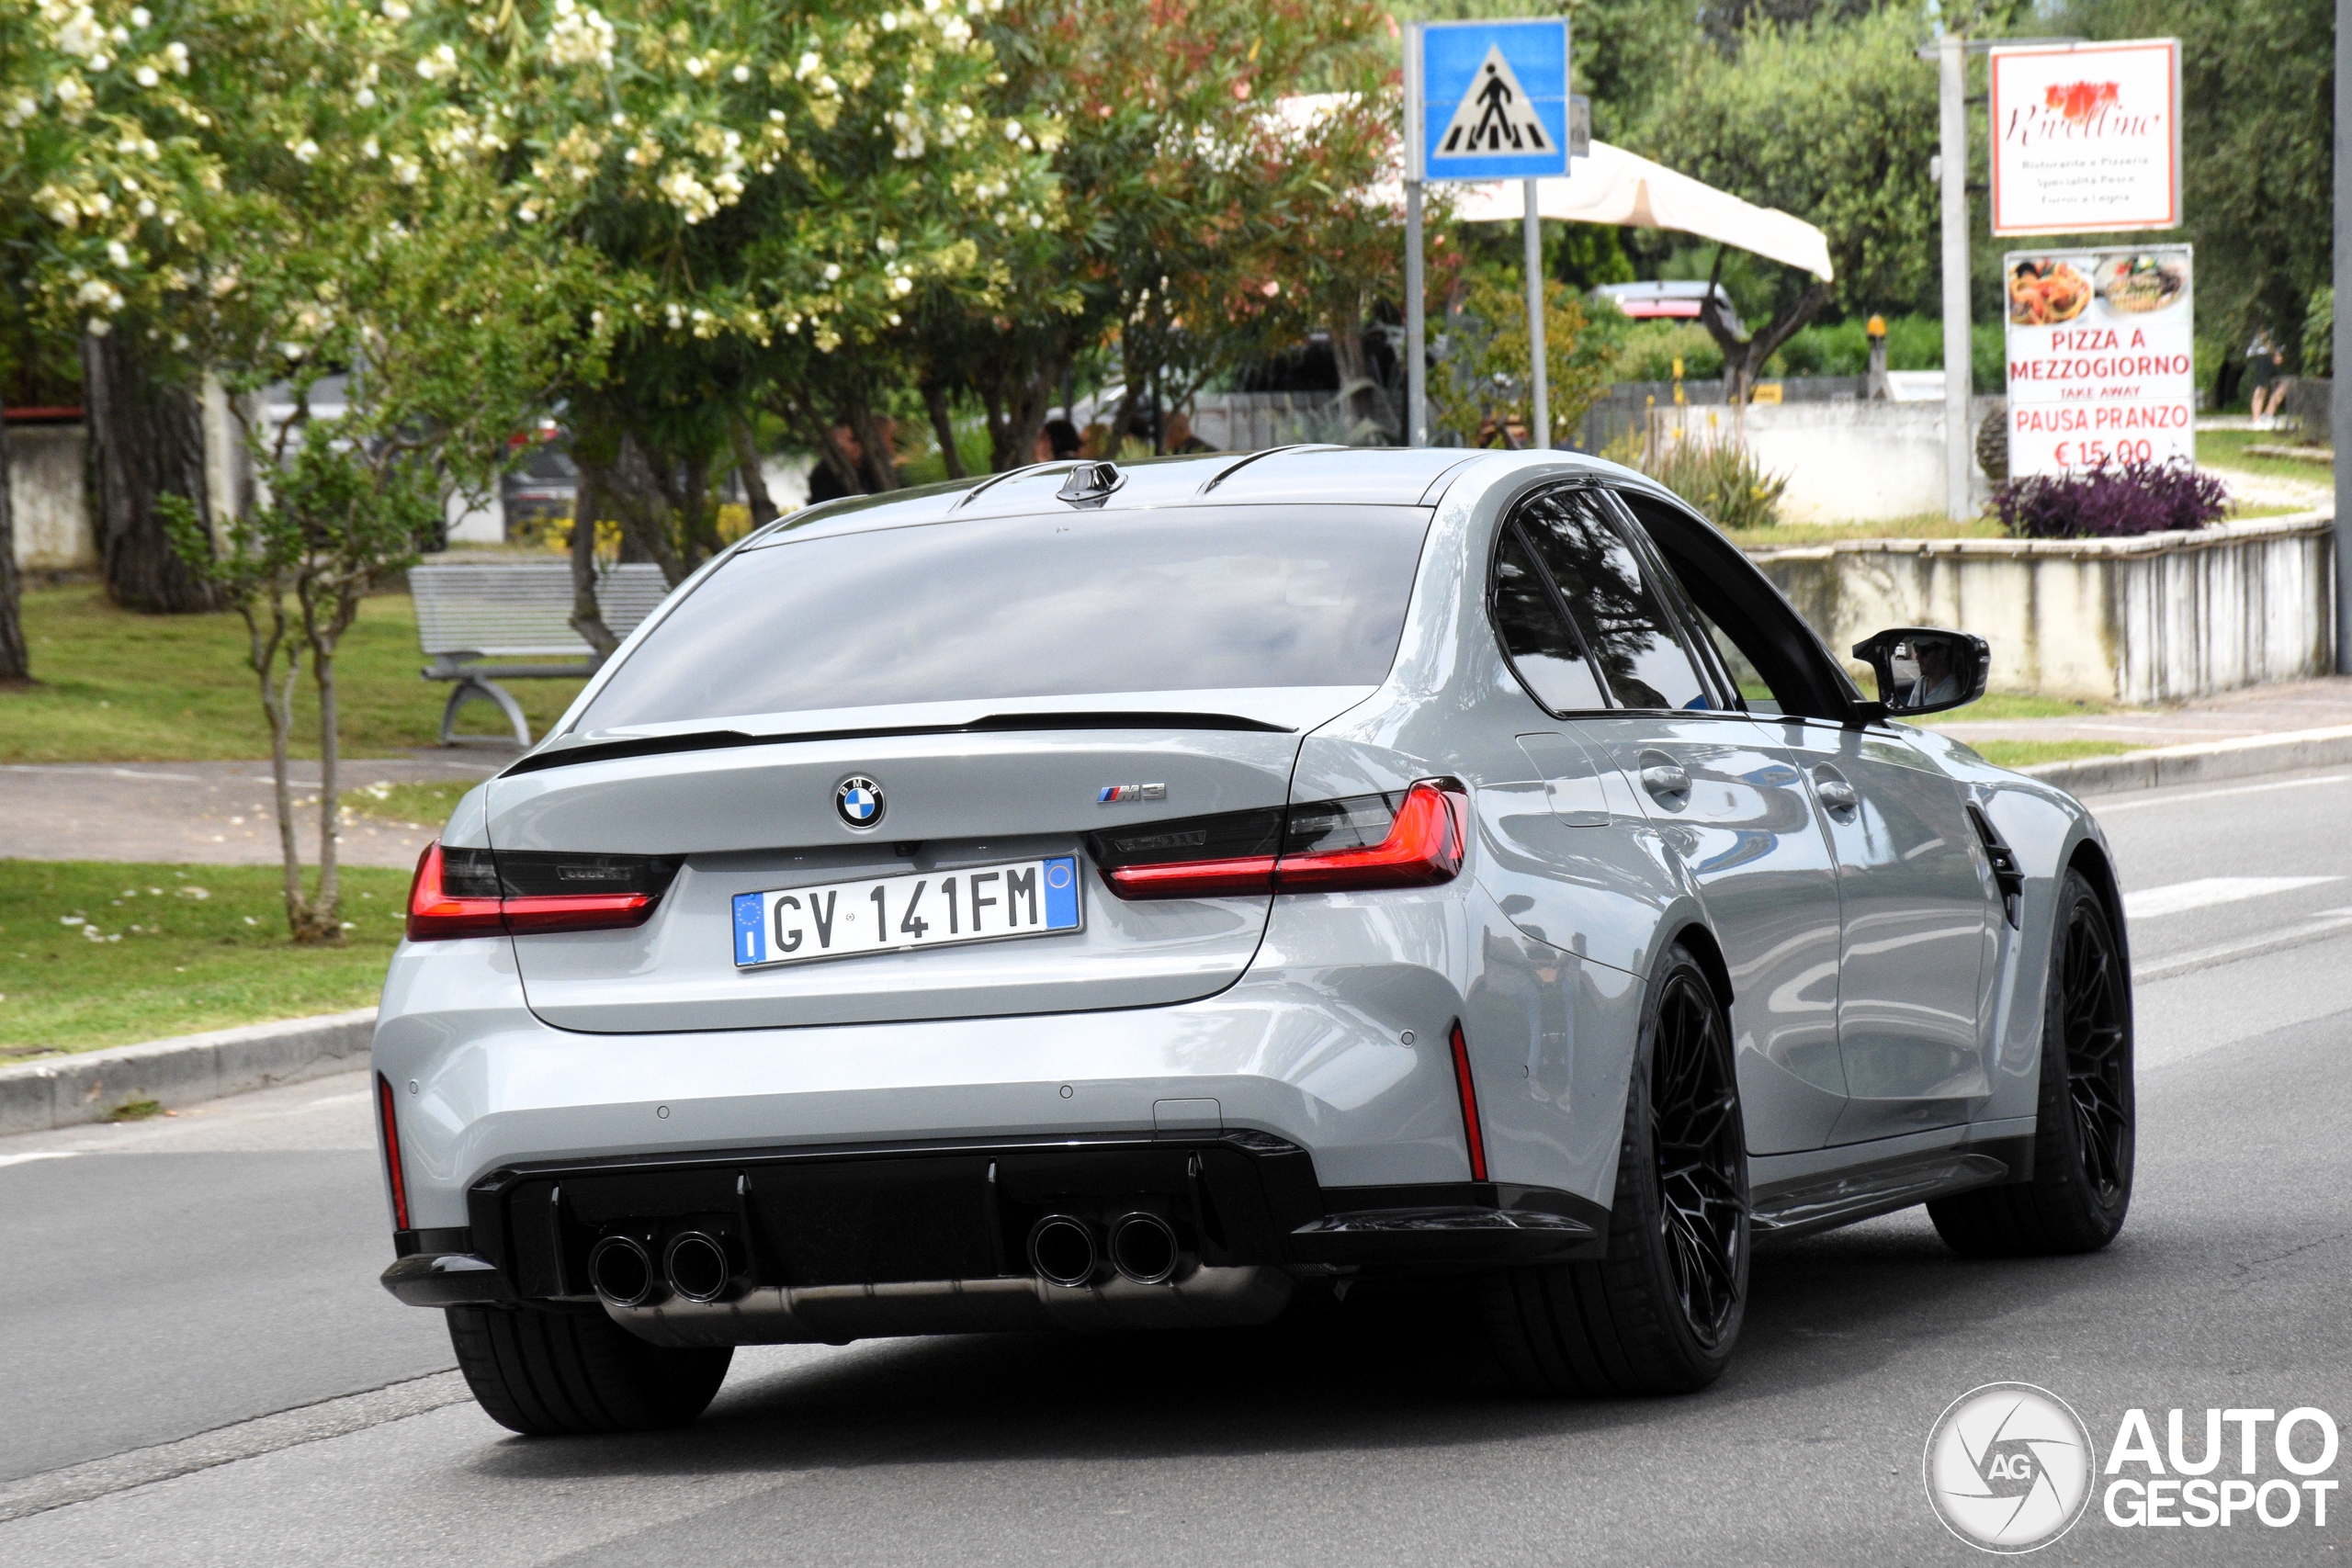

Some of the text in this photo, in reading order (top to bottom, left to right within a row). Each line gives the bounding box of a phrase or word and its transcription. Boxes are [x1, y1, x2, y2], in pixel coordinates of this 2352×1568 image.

[2006, 100, 2161, 147] Rivellino
[2052, 327, 2146, 352] PIZZA A
[2011, 355, 2189, 380] MEZZOGIORNO
[2061, 385, 2141, 399] TAKE AWAY
[2017, 405, 2188, 433] PAUSA PRANZO
[2054, 441, 2070, 467] €
[839, 779, 879, 796] BMW
[1114, 783, 1166, 802] M3
[774, 867, 1037, 953] GV 141FM
